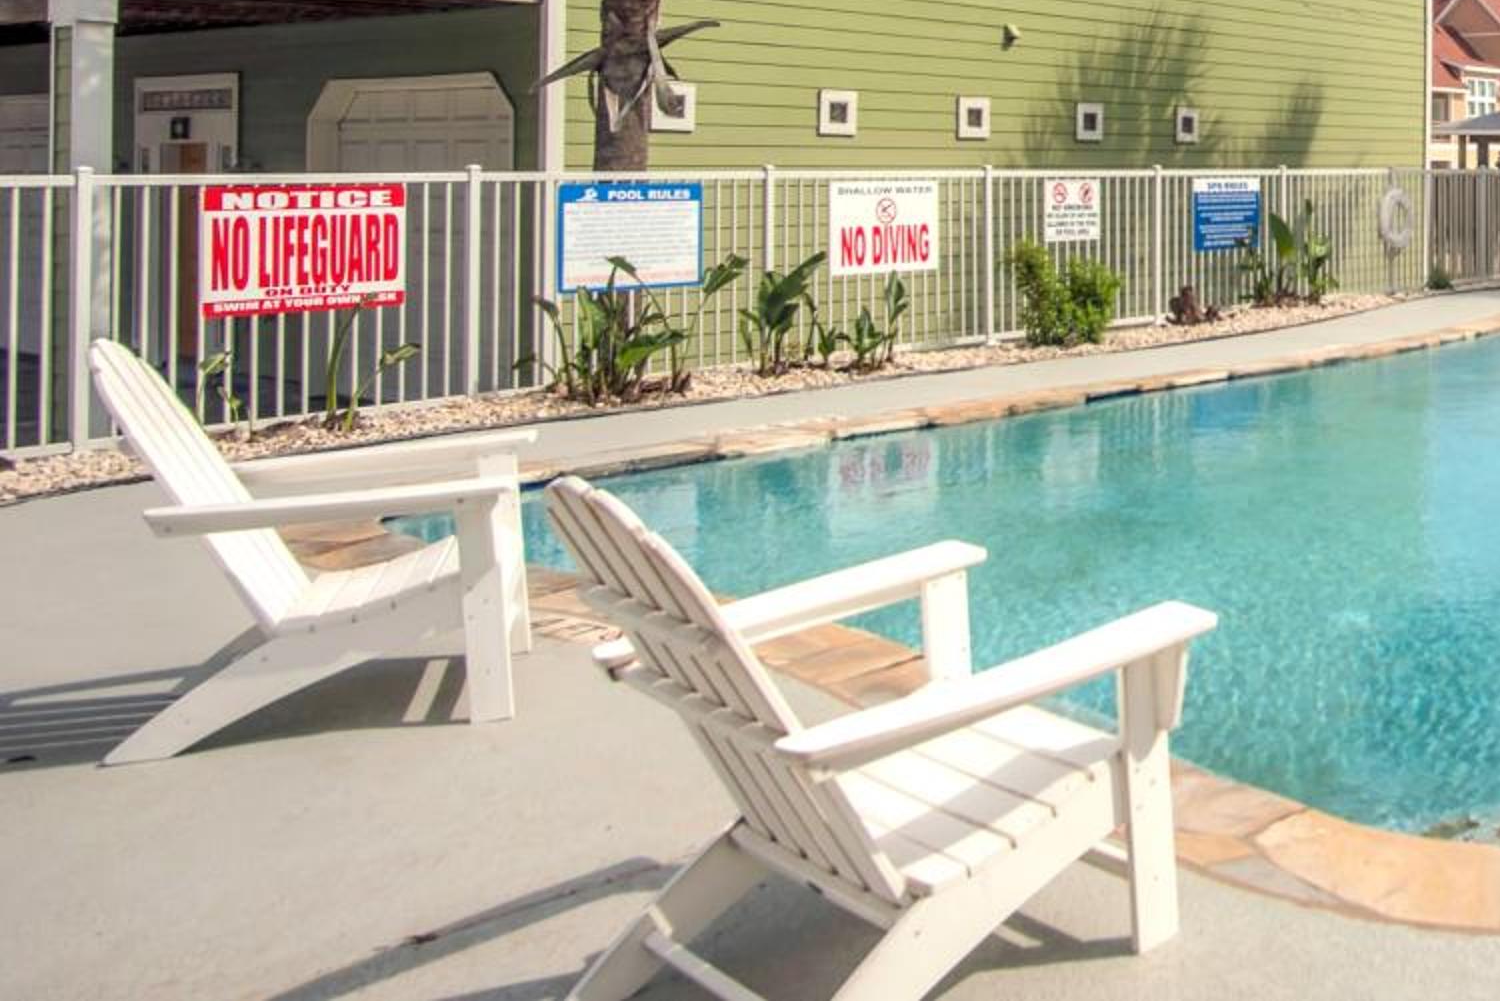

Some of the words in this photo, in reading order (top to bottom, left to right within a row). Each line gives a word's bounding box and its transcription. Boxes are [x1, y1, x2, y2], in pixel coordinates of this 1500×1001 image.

[608, 190, 645, 200] POOL
[648, 189, 691, 199] RULES
[837, 186, 893, 195] SHALLOW
[895, 186, 933, 194] WATER
[221, 189, 393, 211] NOTICE
[211, 216, 250, 291] NO
[258, 212, 399, 289] LIFEGUARD
[841, 225, 867, 267] NO
[872, 223, 930, 265] DIVING
[265, 286, 293, 297] ON
[300, 284, 351, 295] DUTY
[213, 301, 260, 313] SWIM
[263, 300, 282, 311] AT
[285, 297, 324, 309] YOUR
[327, 295, 361, 306] OWN
